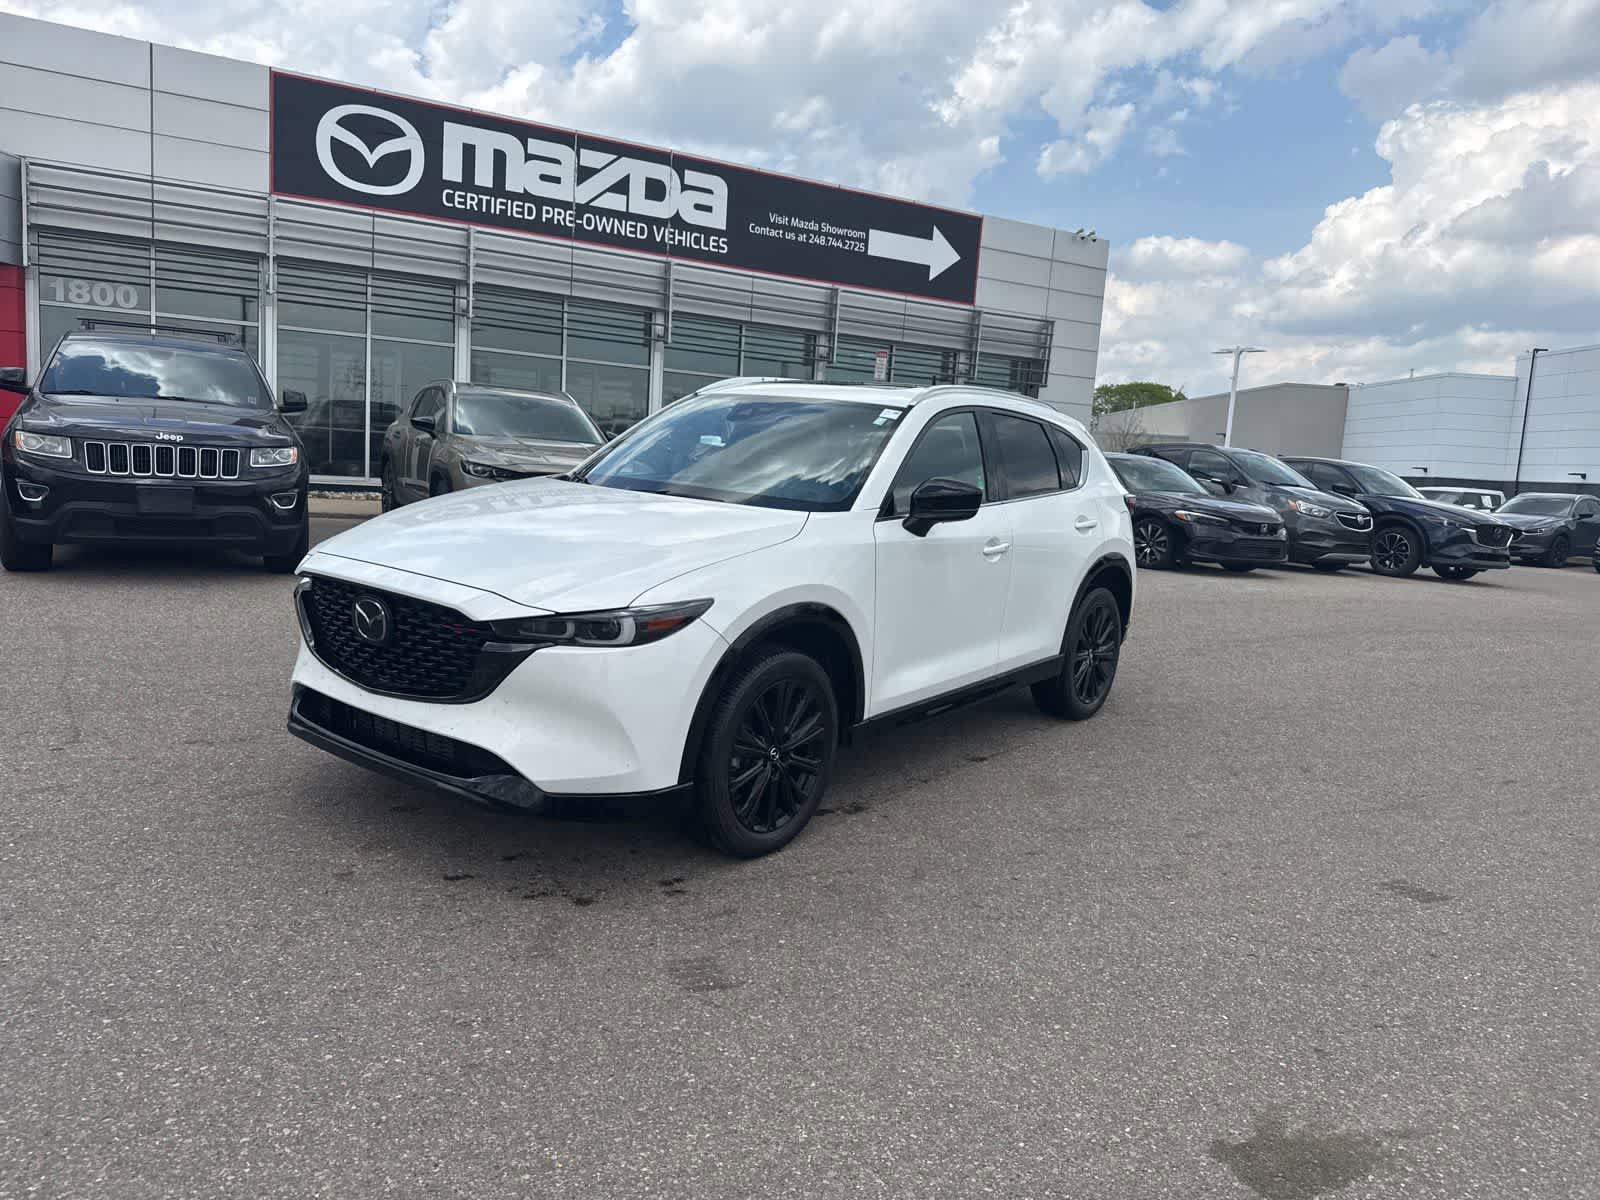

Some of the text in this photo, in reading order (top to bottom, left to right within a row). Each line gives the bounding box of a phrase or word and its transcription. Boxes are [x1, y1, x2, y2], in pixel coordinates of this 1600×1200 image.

[442, 189, 728, 254] CERTIFIED PRE-OWNED VEHICLES
[769, 212, 866, 239] Visit Mazda Showroom
[749, 223, 865, 252] Contact us at 248.744.2725
[48, 277, 138, 309] 1800
[155, 432, 184, 443] Jeep
